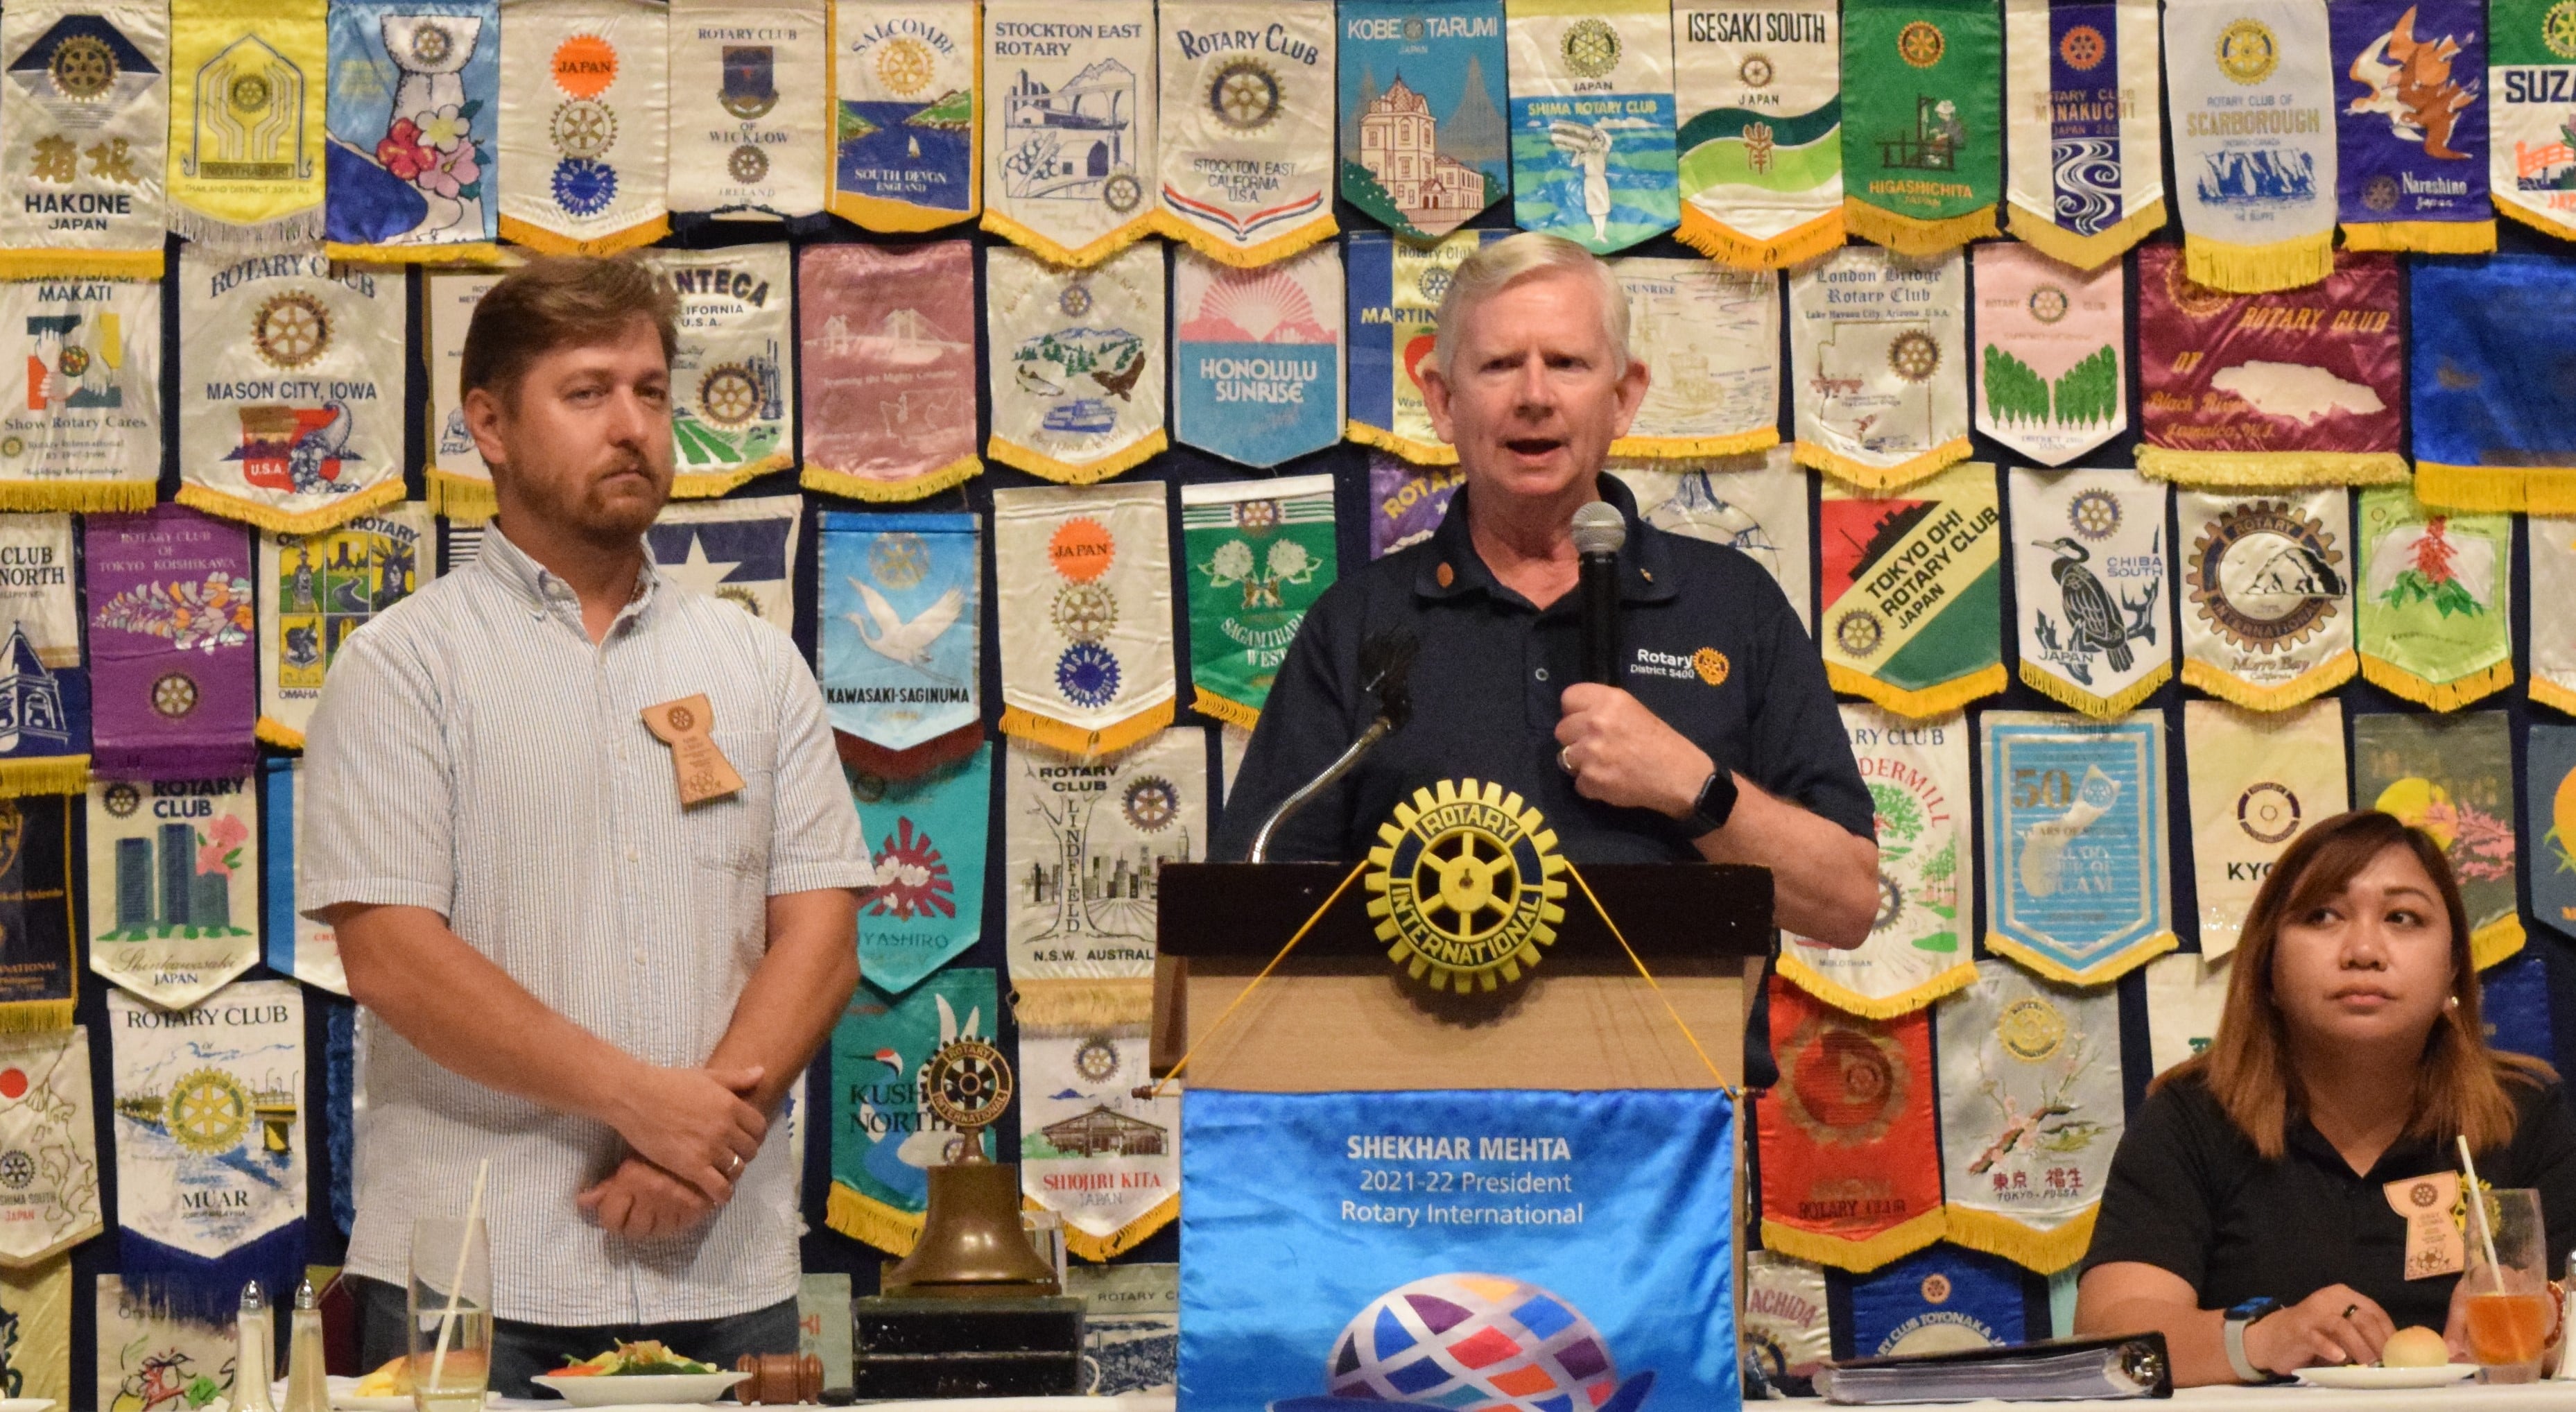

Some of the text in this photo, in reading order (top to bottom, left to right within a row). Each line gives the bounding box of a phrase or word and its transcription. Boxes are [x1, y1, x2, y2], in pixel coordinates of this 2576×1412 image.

[698, 28, 797, 40] ROTARY CLUB
[995, 22, 1142, 39] STOCKTON EAST
[1347, 17, 1402, 40] KOBE
[1426, 17, 1498, 38] TARUMI
[1688, 12, 1826, 44] ISESAKI SOUTH
[852, 18, 957, 58] SALCOMBE
[1177, 23, 1320, 67] ROTARY CLUB
[995, 41, 1072, 56] ROTARY
[1398, 45, 1428, 55] JAPAN
[558, 62, 611, 74] JAPAN
[1573, 81, 1613, 92] JAPAN
[2505, 70, 2576, 103] SUZ
[1738, 94, 1779, 106] JAPAN
[2034, 89, 2136, 103] ROTARY CLUB
[2207, 94, 2294, 107] ROTARY CLUB OF
[1528, 101, 1657, 116] SHIMA ROTARY CLUB
[2034, 103, 2136, 122] MINAKUCHI
[740, 121, 757, 132] OF
[2052, 123, 2086, 135] JAPAN
[2186, 109, 2320, 136] SCARBOROUGH
[709, 130, 789, 144] WICKLOW
[560, 157, 607, 182] OSAKA
[1193, 159, 1297, 174] STOCKTON EAST
[854, 169, 946, 183] SOUTH DEVON
[1207, 173, 1280, 189] CALIFORNIA
[230, 184, 269, 194] DISTRICT
[719, 187, 776, 197] IRELAND
[876, 182, 927, 193] ENGLAND
[1869, 180, 1973, 198] HIGASHICHITA
[25, 193, 130, 214] HAKONE
[48, 217, 107, 231] JAPAN
[208, 255, 303, 299] ROTARY
[1816, 268, 1876, 284] London
[37, 285, 112, 302] MAKATI
[1626, 284, 1677, 295] SUNRISE
[1826, 287, 1930, 304] Rotary Club
[681, 317, 722, 327] U.S.A.
[1360, 307, 1438, 325] MARTIN
[1806, 310, 1826, 320] Lake
[2240, 307, 2391, 334] ROTARY CLUB
[1200, 358, 1317, 381] HONOLULU
[207, 381, 377, 402] MASON CITY, IOWA
[1216, 380, 1305, 404] SUNRISE
[4, 415, 147, 431] Show Rotary Cares
[349, 517, 422, 545] ROTARY
[2233, 515, 2297, 534] ROTARY
[120, 531, 211, 544] ROTARY CLUB
[1, 546, 53, 565] CLUB
[158, 546, 173, 557] OF
[1053, 543, 1108, 557] JAPAN
[1865, 508, 1964, 600] TOKYO OHI
[98, 558, 238, 573] TOKYO KOISHIKAWA
[1879, 506, 2000, 618] ROTARY CLUB
[2107, 556, 2163, 568] CHIBA
[0, 565, 65, 586] NORTH
[2107, 566, 2163, 578] SOUTH
[1896, 584, 1946, 630] JAPAN
[1064, 649, 1111, 674] OSAKA
[1637, 648, 1693, 669] Rotary
[2037, 650, 2095, 664] JAPAN
[1630, 664, 1695, 680] District 5400
[278, 689, 319, 700] OMAHA
[827, 687, 969, 704] KAWASAKI-SAGINUMA
[1887, 727, 1946, 747] CLUB
[1039, 765, 1118, 780] ROTARY
[152, 777, 245, 797] ROTARY
[1051, 780, 1107, 793] CLUB
[1857, 757, 1951, 830] DERMILL
[2013, 768, 2073, 809] 50
[153, 799, 213, 818] CLUB
[1424, 802, 1519, 840] ROTARY
[1066, 798, 1080, 934] LINDFIELD
[1390, 884, 1543, 966] INTERNATIONAL
[861, 932, 950, 950] YASHIRO
[1033, 947, 1155, 962] N.S.W. AUSTRAL
[154, 972, 198, 986] JAPAN
[127, 1004, 288, 1029] ROTARY CLUB
[944, 1041, 998, 1062] ROTARY
[933, 1091, 1008, 1123] INTERNATIONAL
[849, 1110, 955, 1134] NORTH
[1347, 1135, 1572, 1162] SHEKHAR MEHTA
[1043, 1171, 1161, 1192] SHIOJIRI KITA
[1360, 1169, 1573, 1194] 2021-22 President
[1993, 1172, 2028, 1191] 東京
[182, 1189, 249, 1211] MUAR
[1080, 1191, 1123, 1207] JAPAN
[4, 1208, 35, 1223] JAPAN
[1341, 1201, 1584, 1229] Rotary International
[1098, 1291, 1156, 1303] ROTARY
[1749, 1289, 1817, 1329] ACHIDA
[1890, 1311, 1994, 1342] CLUB TOYONAKA
